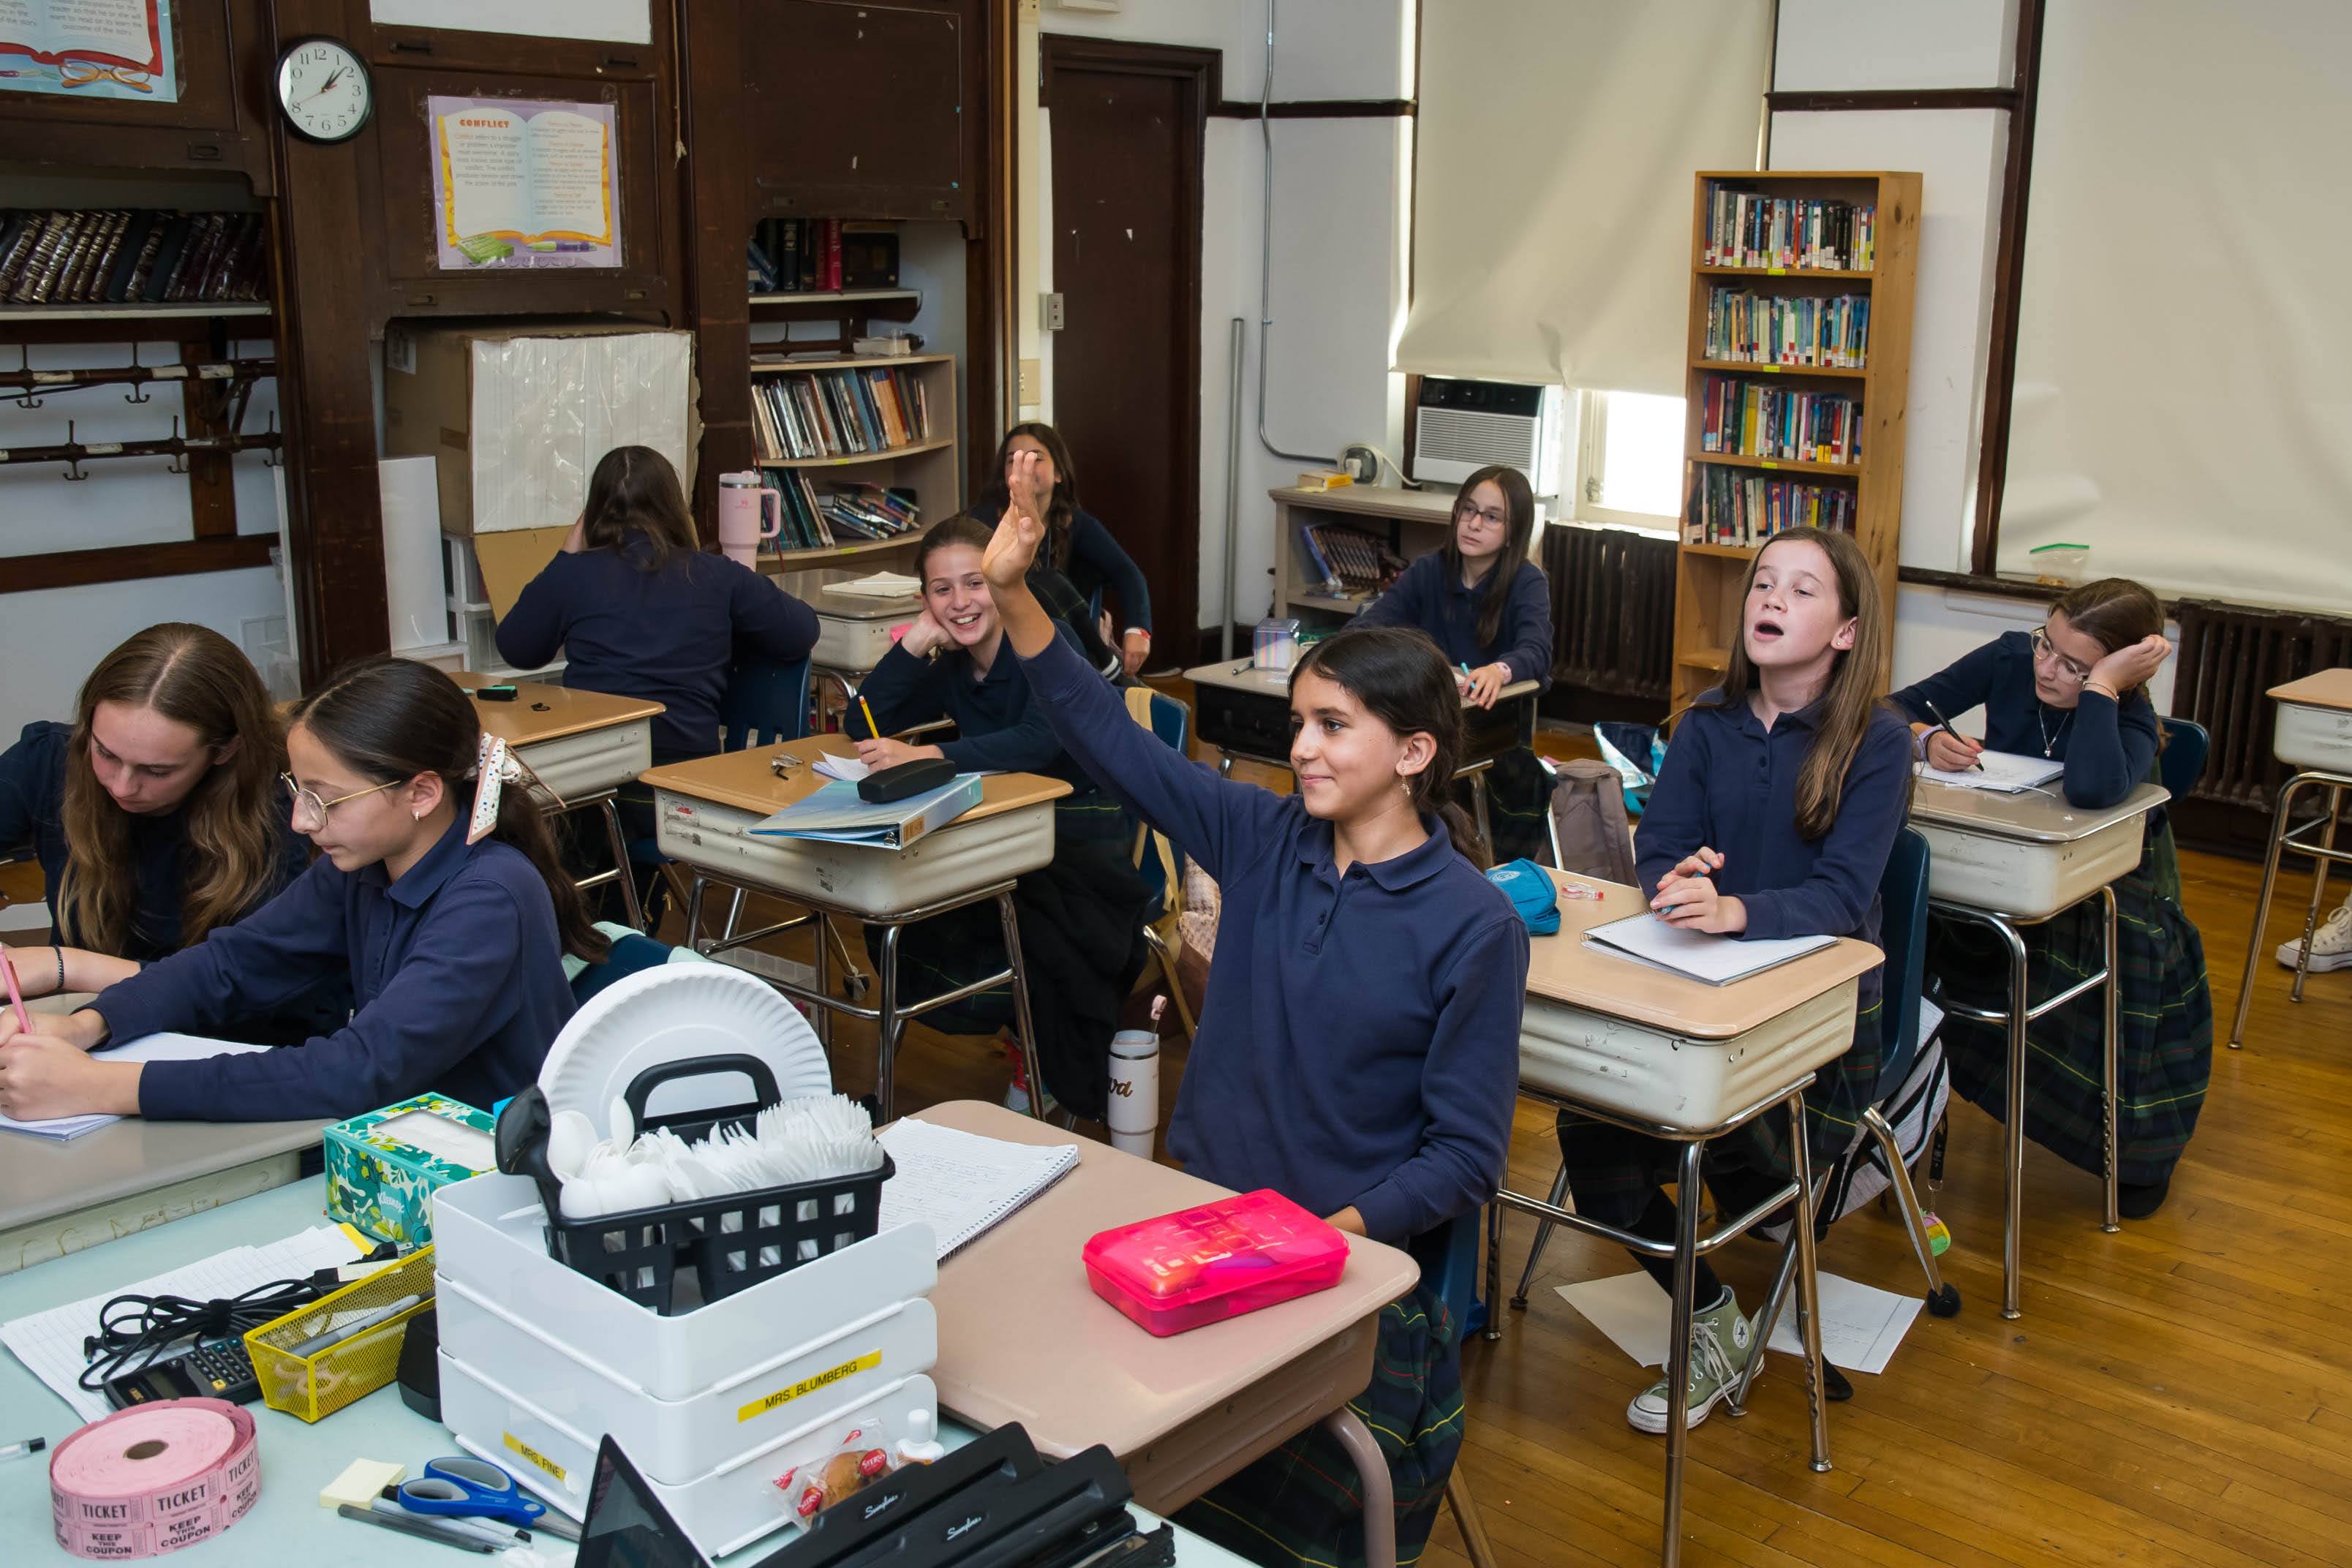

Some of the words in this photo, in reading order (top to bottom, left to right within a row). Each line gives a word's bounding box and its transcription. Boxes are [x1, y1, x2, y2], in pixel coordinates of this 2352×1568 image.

[301, 53, 309, 65] 11
[314, 48, 327, 61] 12
[336, 53, 340, 66] 1
[344, 66, 355, 78] 2
[352, 85, 361, 97] 3
[292, 102, 301, 114] 8
[347, 103, 358, 115] 4
[305, 115, 314, 127] 7
[322, 119, 331, 132] 6
[338, 115, 347, 127] 5
[459, 118, 510, 129] CONFLICT
[764, 1389, 794, 1409] MRS.
[796, 1361, 858, 1396] BLUMBERG
[228, 1450, 255, 1483] TICKET
[520, 1444, 540, 1465] MRS.
[542, 1458, 561, 1478] FINE
[157, 1483, 206, 1512] TICKET
[81, 1503, 128, 1519] TICKET
[169, 1515, 202, 1533] KEEP
[91, 1533, 123, 1542] KEEP
[160, 1524, 211, 1548] COUPON
[86, 1545, 132, 1555] COUPON
